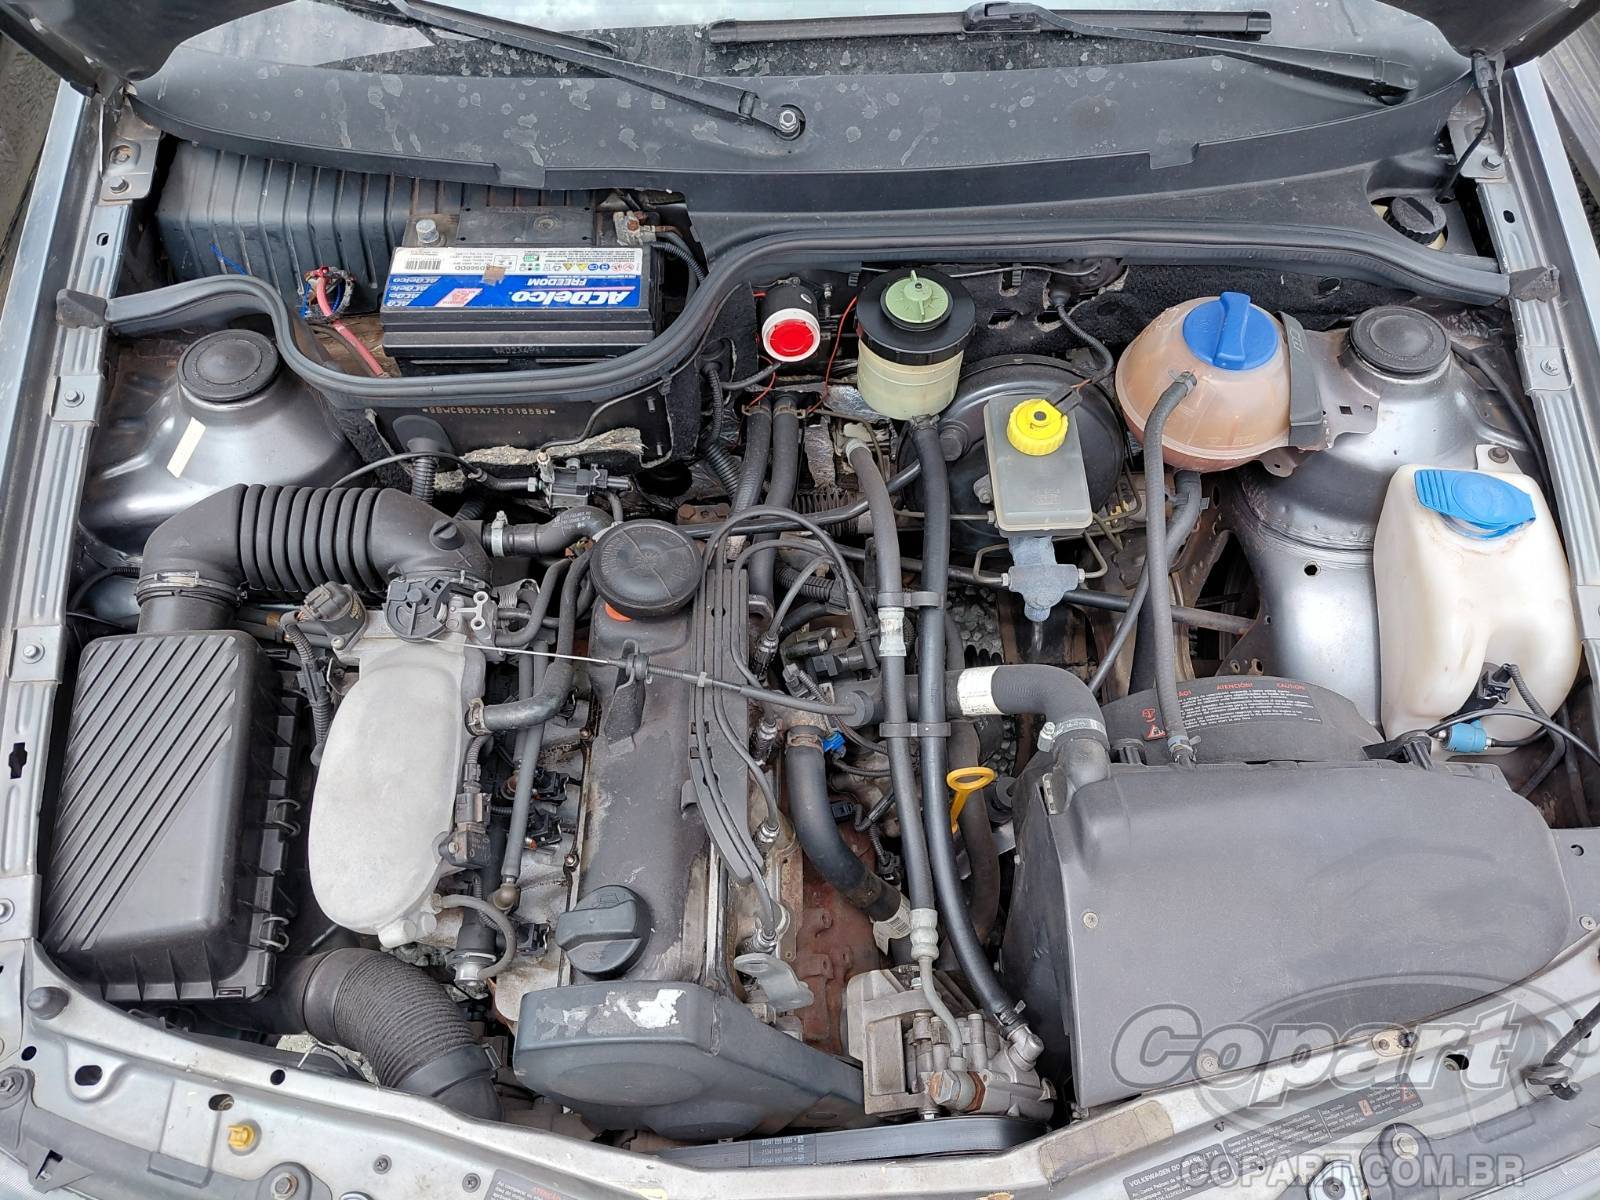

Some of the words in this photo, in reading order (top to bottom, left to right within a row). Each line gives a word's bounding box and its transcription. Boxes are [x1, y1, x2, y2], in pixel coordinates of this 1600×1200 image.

[527, 278, 588, 287] FREEDOM
[510, 290, 631, 305] ACDelco
[1129, 1168, 1171, 1187] VOLKSWAGEN
